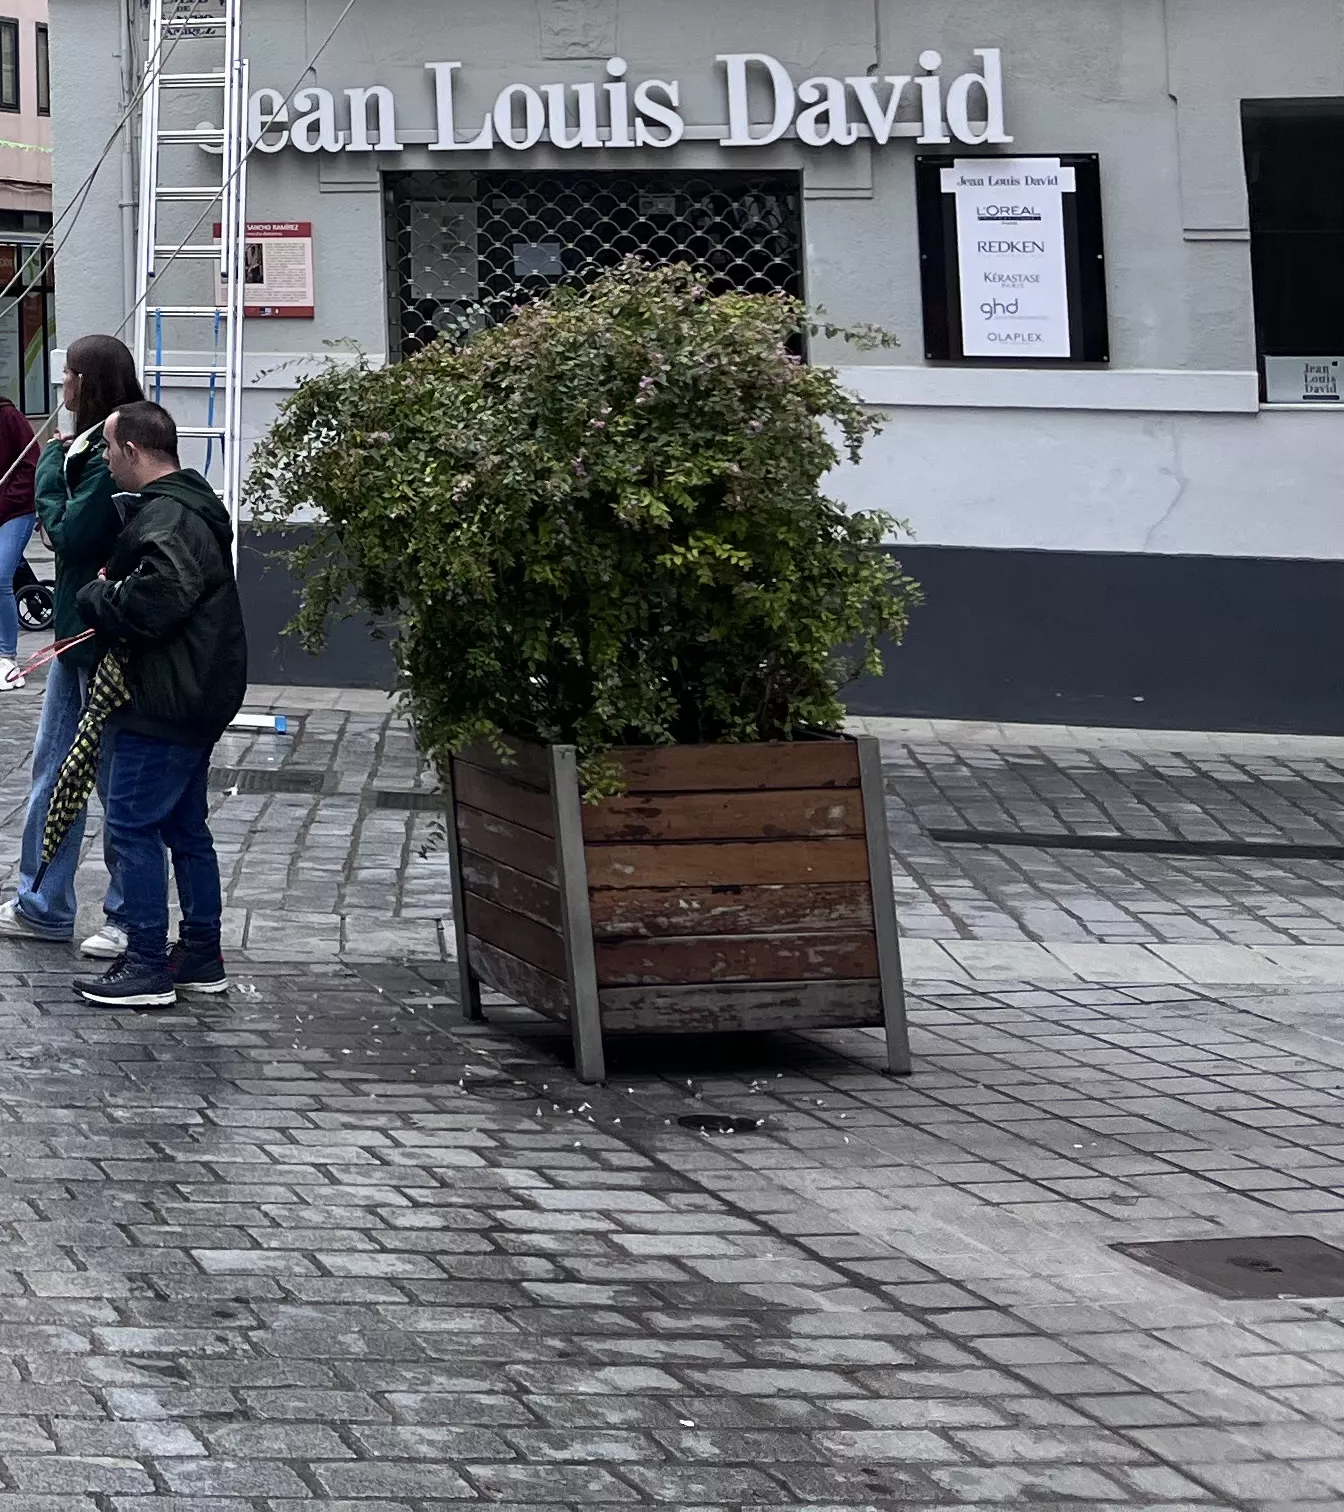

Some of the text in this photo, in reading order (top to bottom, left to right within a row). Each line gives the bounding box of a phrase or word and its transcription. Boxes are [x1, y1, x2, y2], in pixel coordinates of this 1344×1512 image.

[424, 56, 685, 152] Louis
[715, 47, 1014, 148] David
[957, 175, 1059, 187] Jean Louis David
[977, 240, 1045, 253] REDKEN
[983, 272, 1041, 283] KÉRASTASE
[980, 297, 1019, 320] ghd
[987, 332, 1043, 342] OLAPLEX
